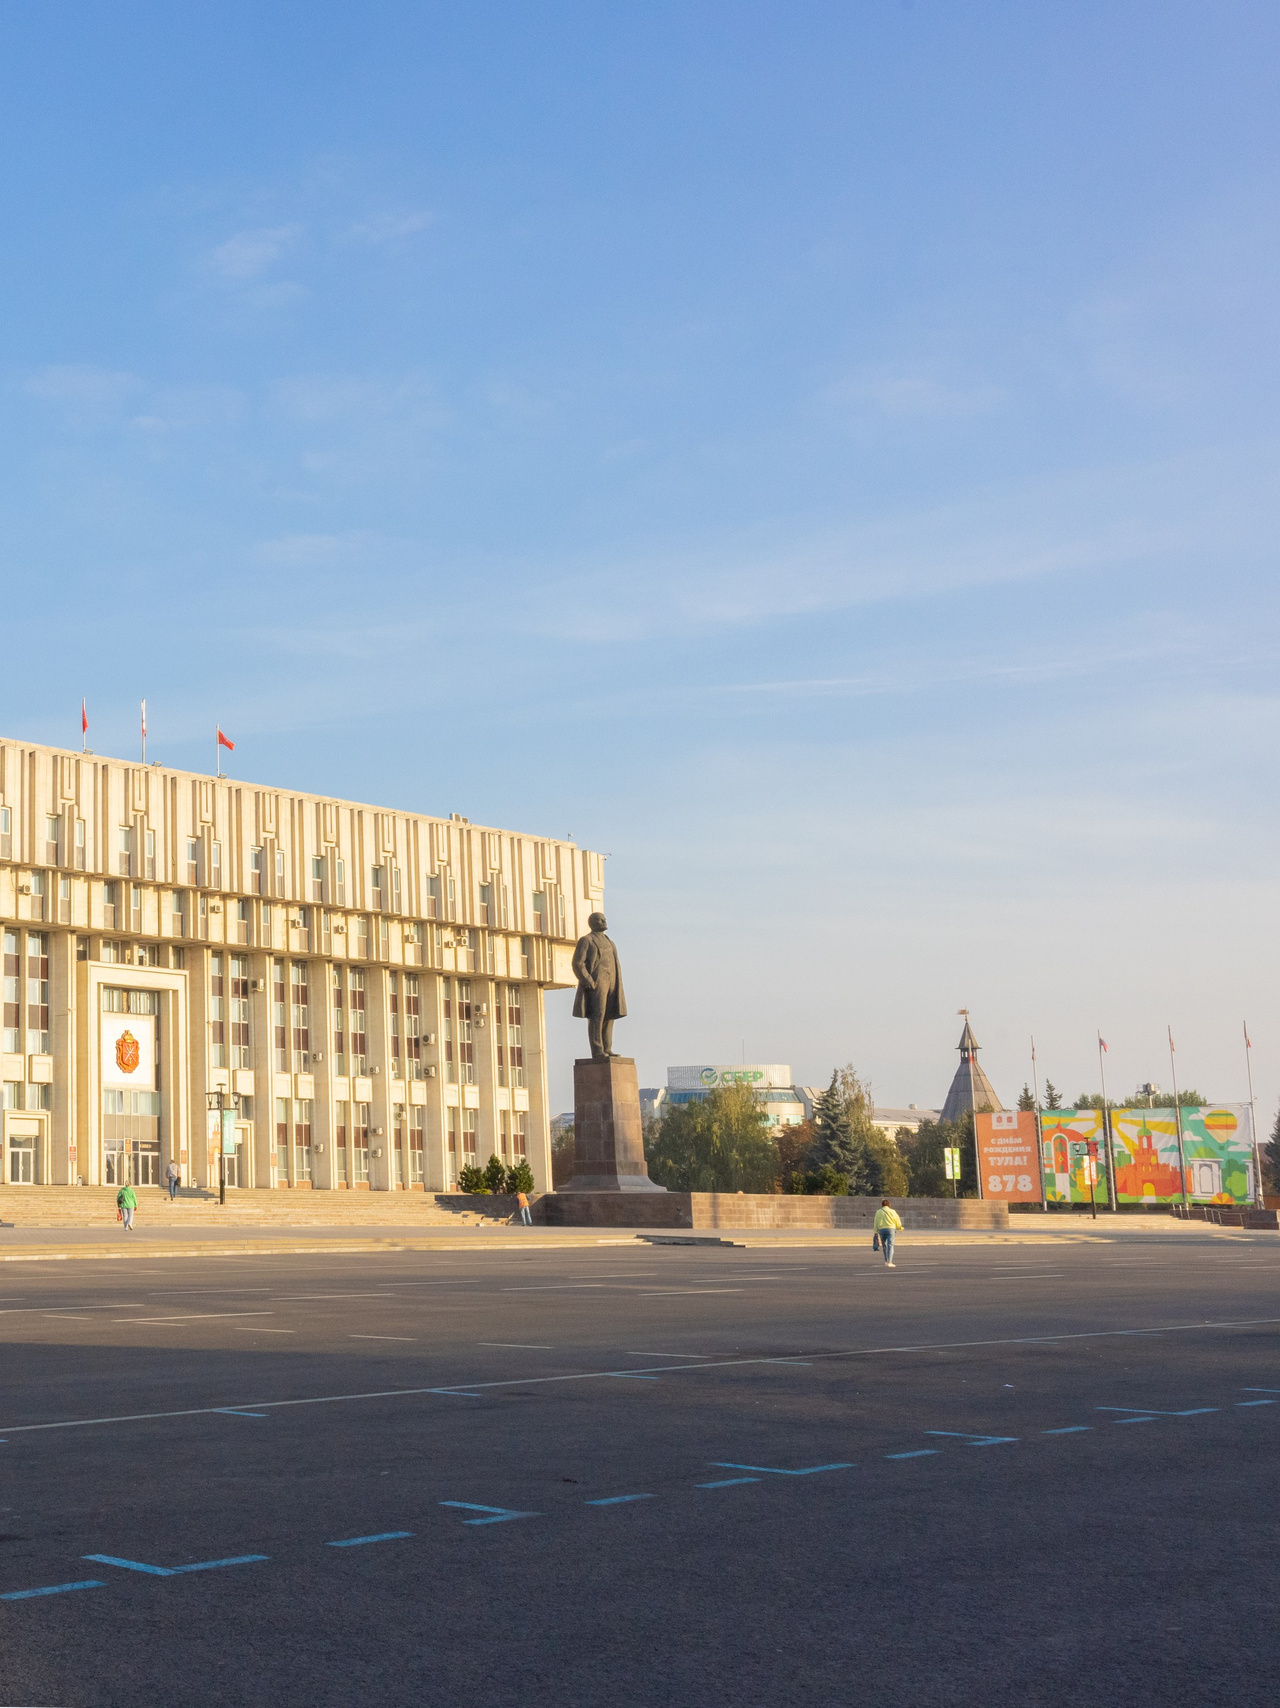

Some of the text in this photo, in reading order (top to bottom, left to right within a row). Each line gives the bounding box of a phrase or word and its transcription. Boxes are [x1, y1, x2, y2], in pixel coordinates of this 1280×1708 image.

[997, 1136, 1022, 1145] ДНЁМ
[988, 1156, 1028, 1166] ТУЛА!
[988, 1174, 1033, 1192] 878
